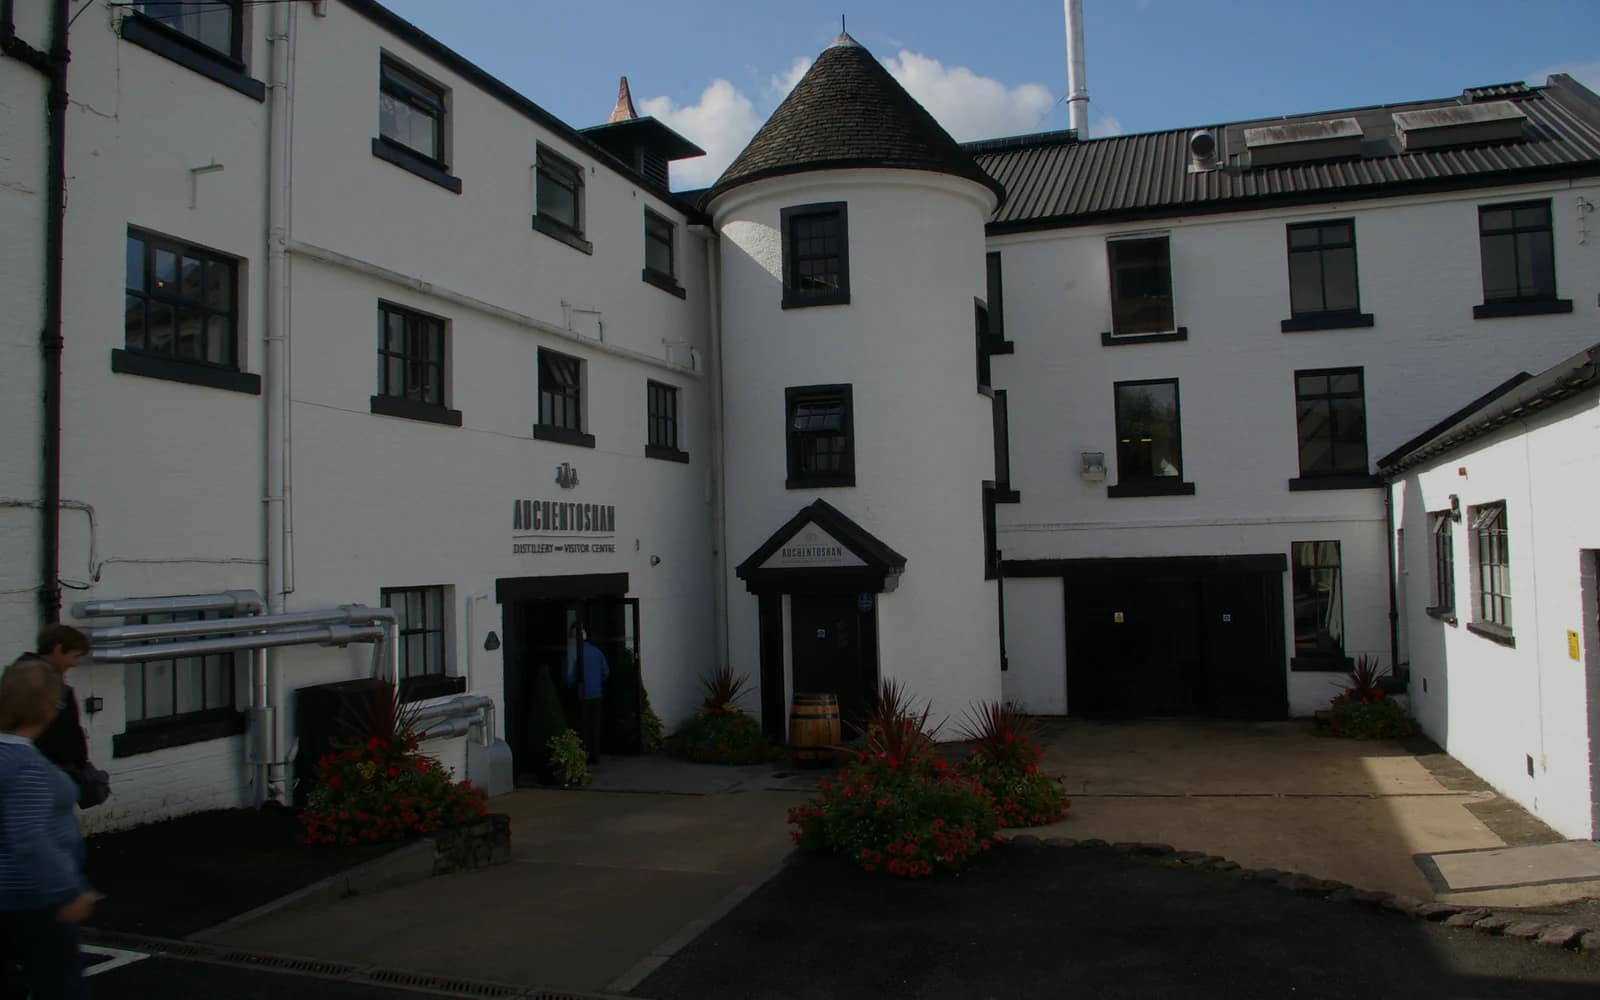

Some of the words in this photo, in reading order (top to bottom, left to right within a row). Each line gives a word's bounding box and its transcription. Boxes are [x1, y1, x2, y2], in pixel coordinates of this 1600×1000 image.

[513, 499, 615, 531] AUCHENTOSHAN
[513, 543, 553, 553] DISTILLERY
[564, 543, 589, 553] VISITOR
[591, 543, 615, 553] CENTRE
